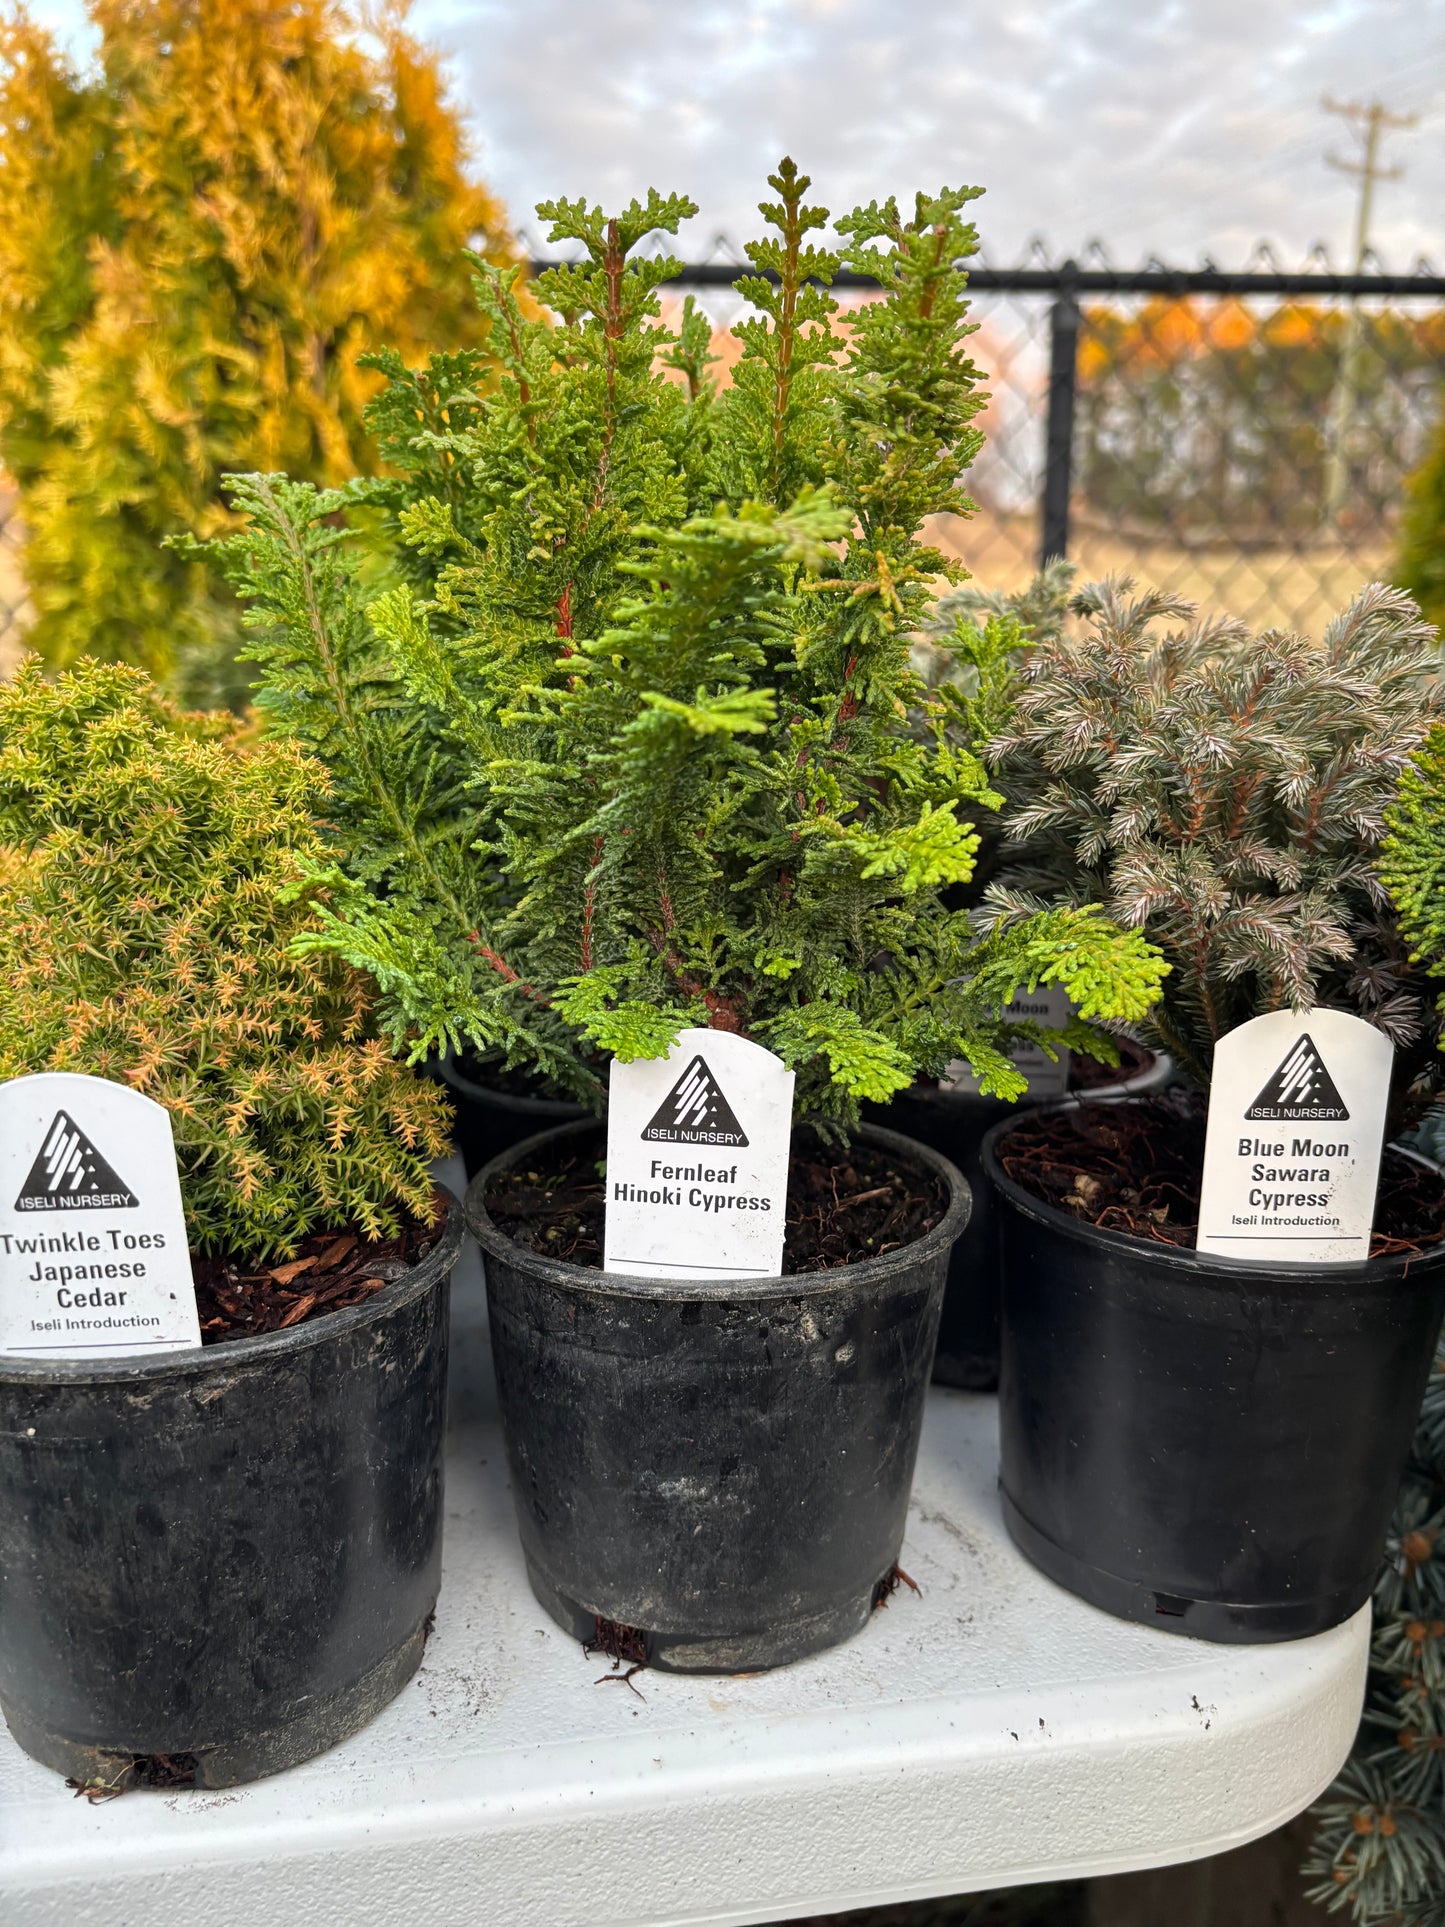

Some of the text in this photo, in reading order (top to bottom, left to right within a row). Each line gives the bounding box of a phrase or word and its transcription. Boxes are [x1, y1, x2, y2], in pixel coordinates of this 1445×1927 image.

[1250, 1108, 1344, 1118] ISELI NURSERY
[647, 1129, 743, 1144] ISELI NURSERY
[1238, 1139, 1349, 1157] Blue Moon
[651, 1160, 737, 1183] Fernleaf
[1251, 1164, 1330, 1182] Sawara
[20, 1194, 131, 1209] ISELI NURSERY
[614, 1183, 771, 1213] Hinoki Cypress
[1249, 1189, 1329, 1211] Cypress
[1231, 1215, 1340, 1226] Iseli Introduction
[0, 1230, 166, 1254] Twinkle Toes
[29, 1262, 147, 1285] Japanese
[57, 1288, 127, 1308] Cedar
[31, 1315, 160, 1331] Iseli Introduction
